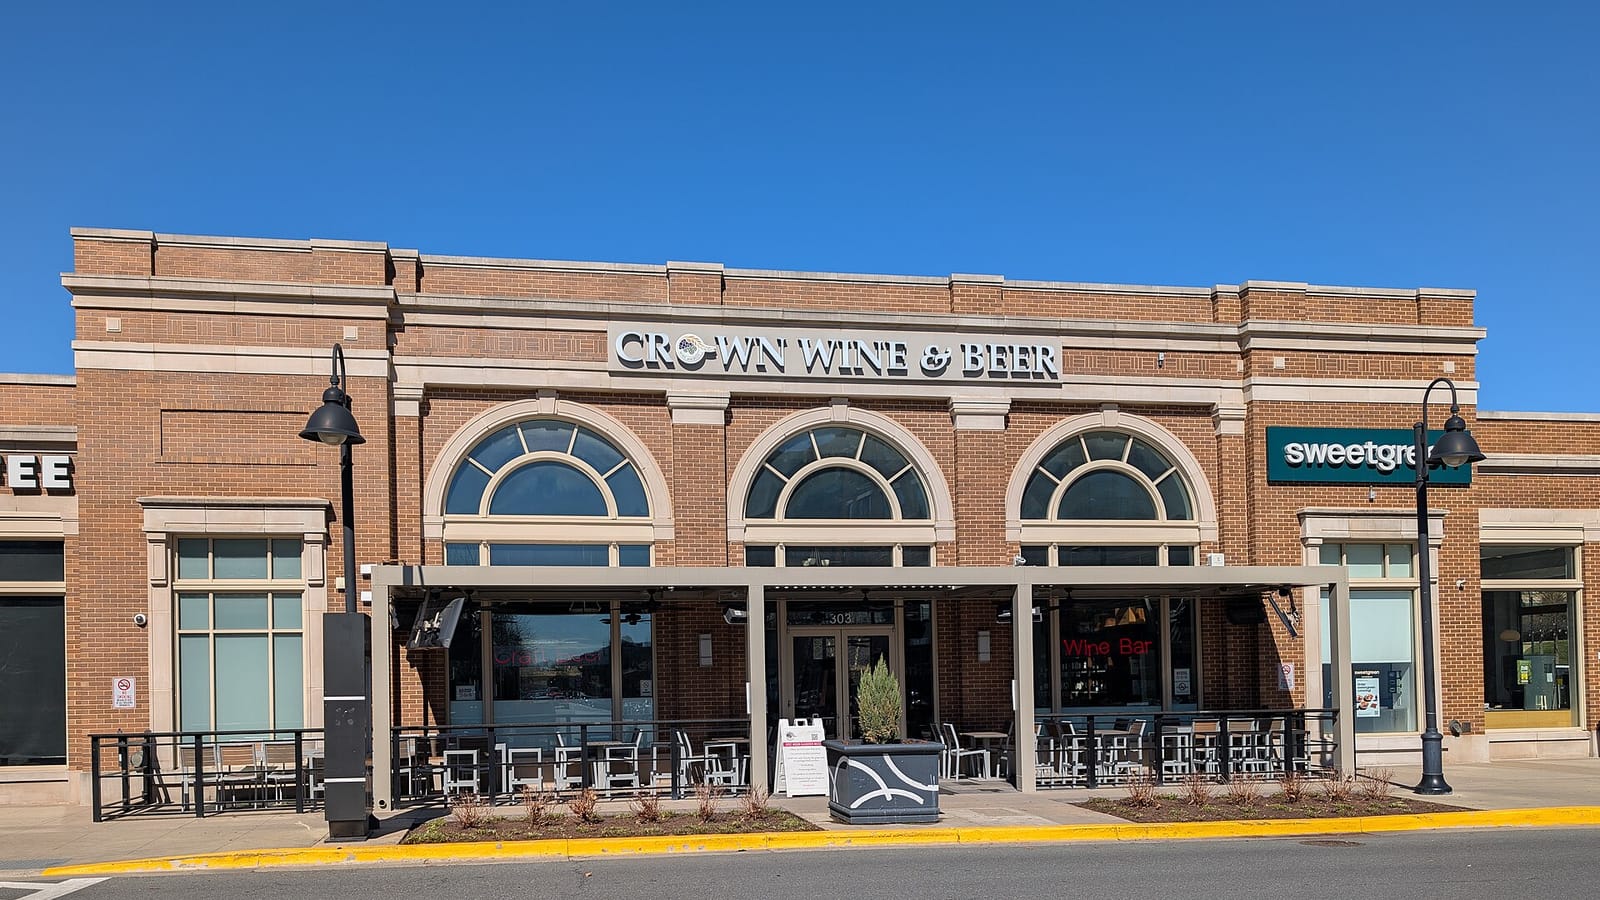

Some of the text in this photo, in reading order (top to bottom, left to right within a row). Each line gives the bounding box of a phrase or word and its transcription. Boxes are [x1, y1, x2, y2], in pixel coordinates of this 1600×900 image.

[615, 331, 1059, 379] CROWN WINE & BEER
[0, 454, 71, 488] EE
[1284, 440, 1436, 471] sweetgre
[830, 613, 852, 624] 303
[1063, 637, 1153, 656] Wine Bar
